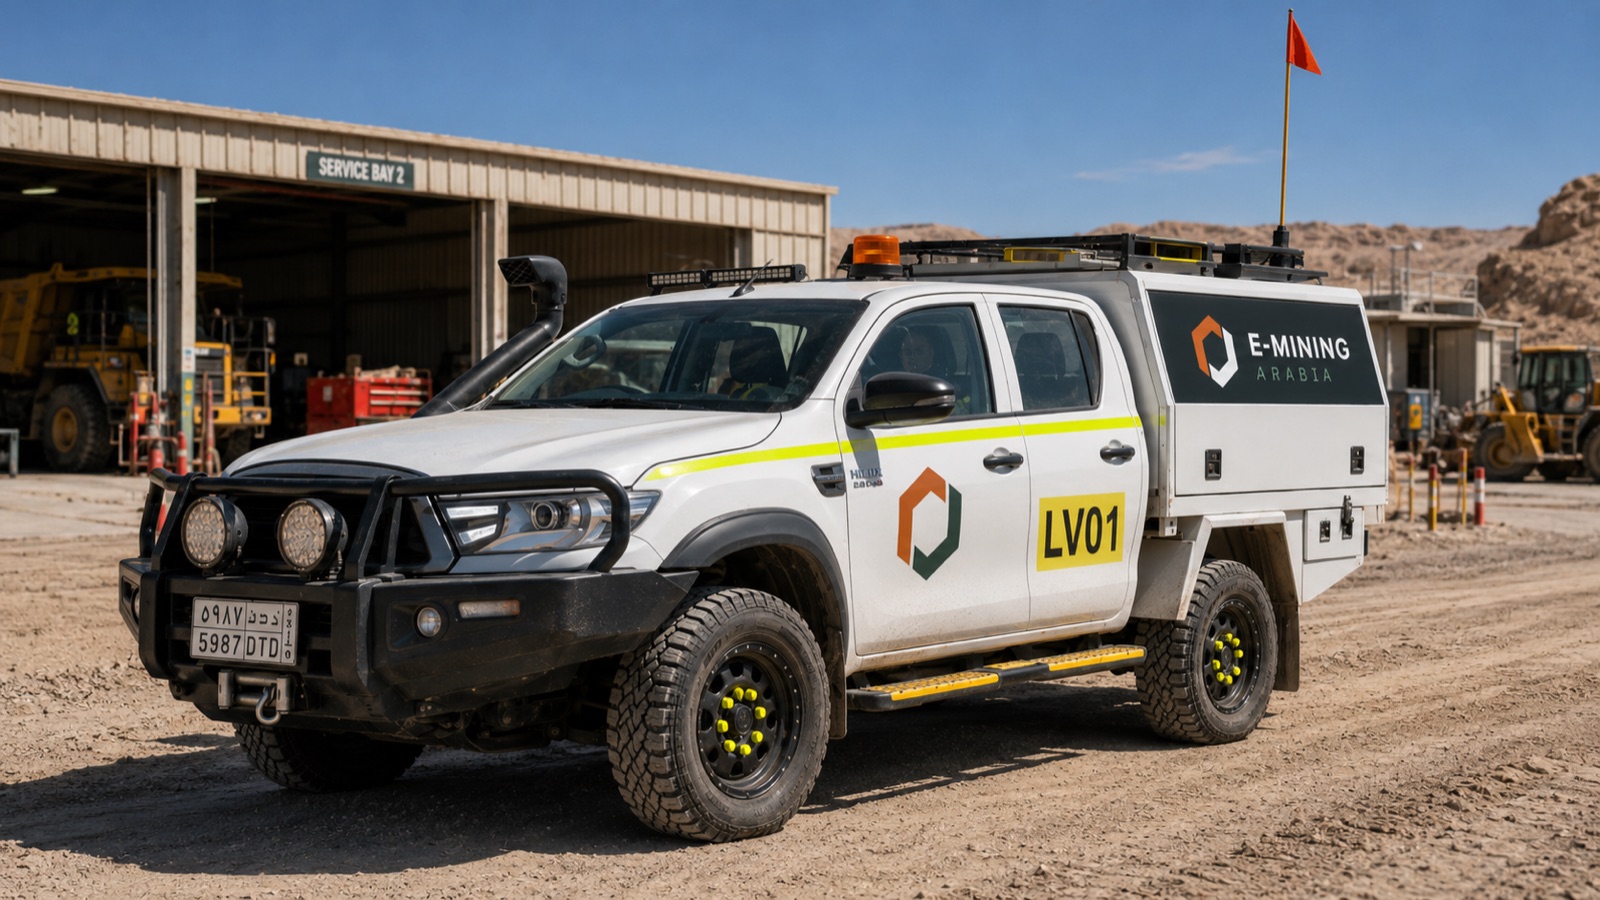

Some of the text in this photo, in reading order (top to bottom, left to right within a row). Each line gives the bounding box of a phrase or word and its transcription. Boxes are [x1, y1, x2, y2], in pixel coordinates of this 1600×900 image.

[318, 157, 405, 185] SERVICE BAY 2
[1247, 332, 1350, 360] E-MINING
[1256, 366, 1332, 382] ARABIA
[1044, 505, 1118, 558] LV01
[199, 632, 279, 659] 5987 DTD
